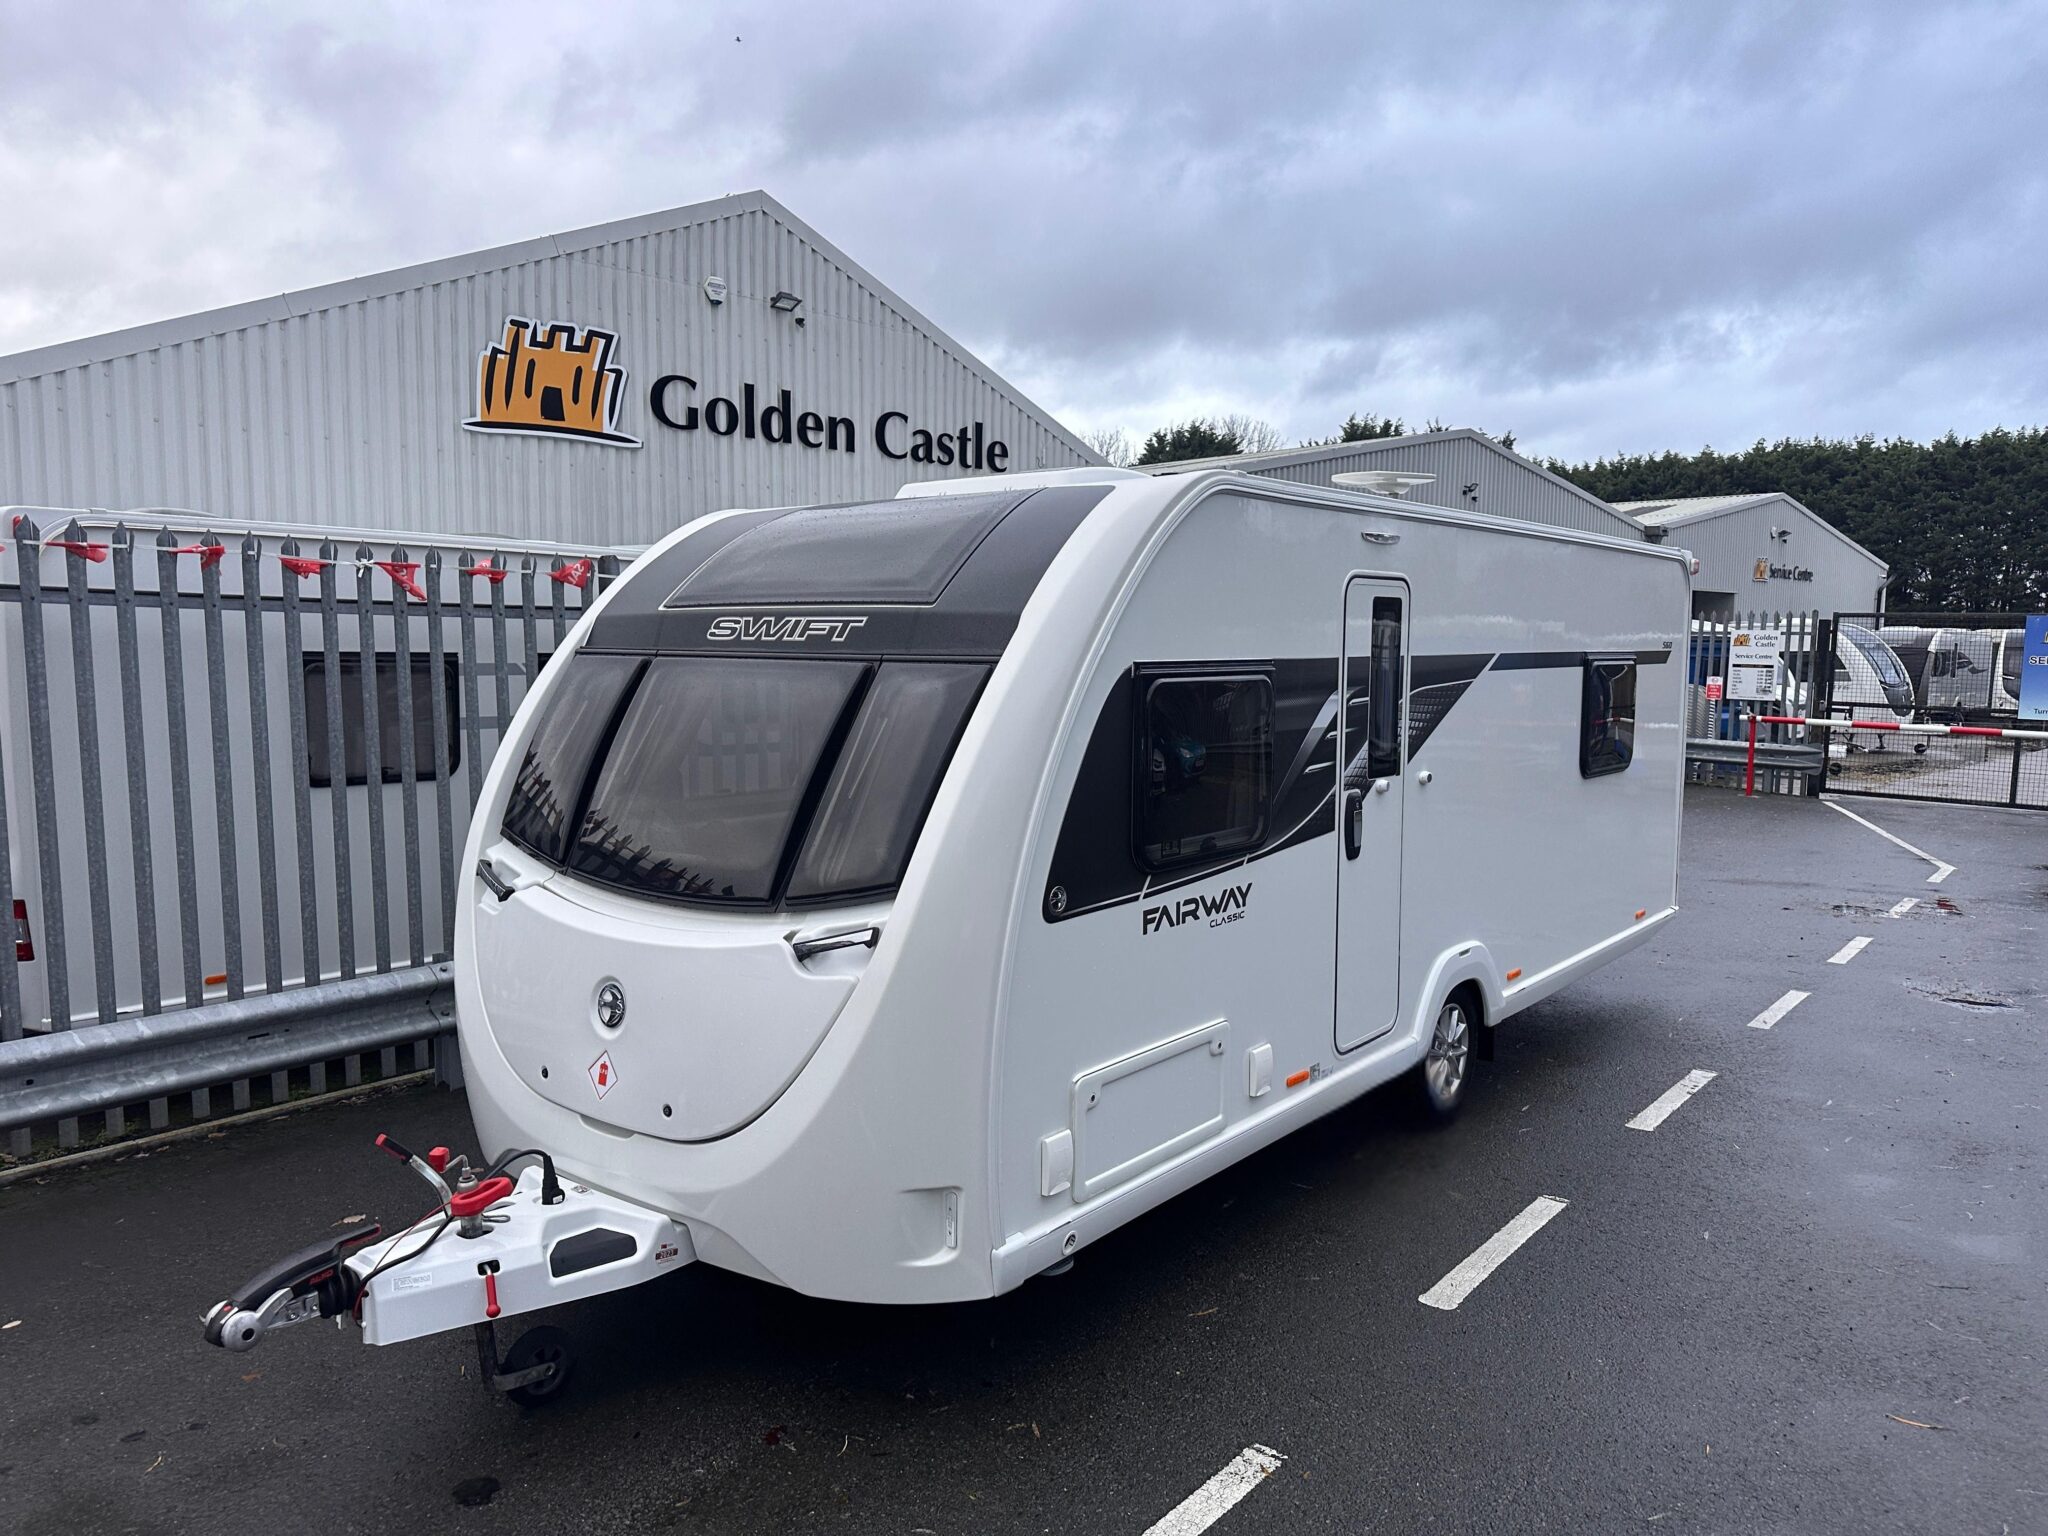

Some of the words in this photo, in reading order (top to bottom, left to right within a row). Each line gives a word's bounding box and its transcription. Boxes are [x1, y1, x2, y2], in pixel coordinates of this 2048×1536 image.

[650, 374, 855, 453] Golden
[875, 411, 1009, 473] Castle
[1770, 563, 1792, 580] Service
[1793, 566, 1813, 582] Centre
[707, 616, 869, 642] SWIFT
[1662, 641, 1673, 649] 560
[2029, 656, 2048, 665] SE
[1143, 882, 1253, 935] FAIRWAY
[1210, 911, 1246, 927] CLASSIC
